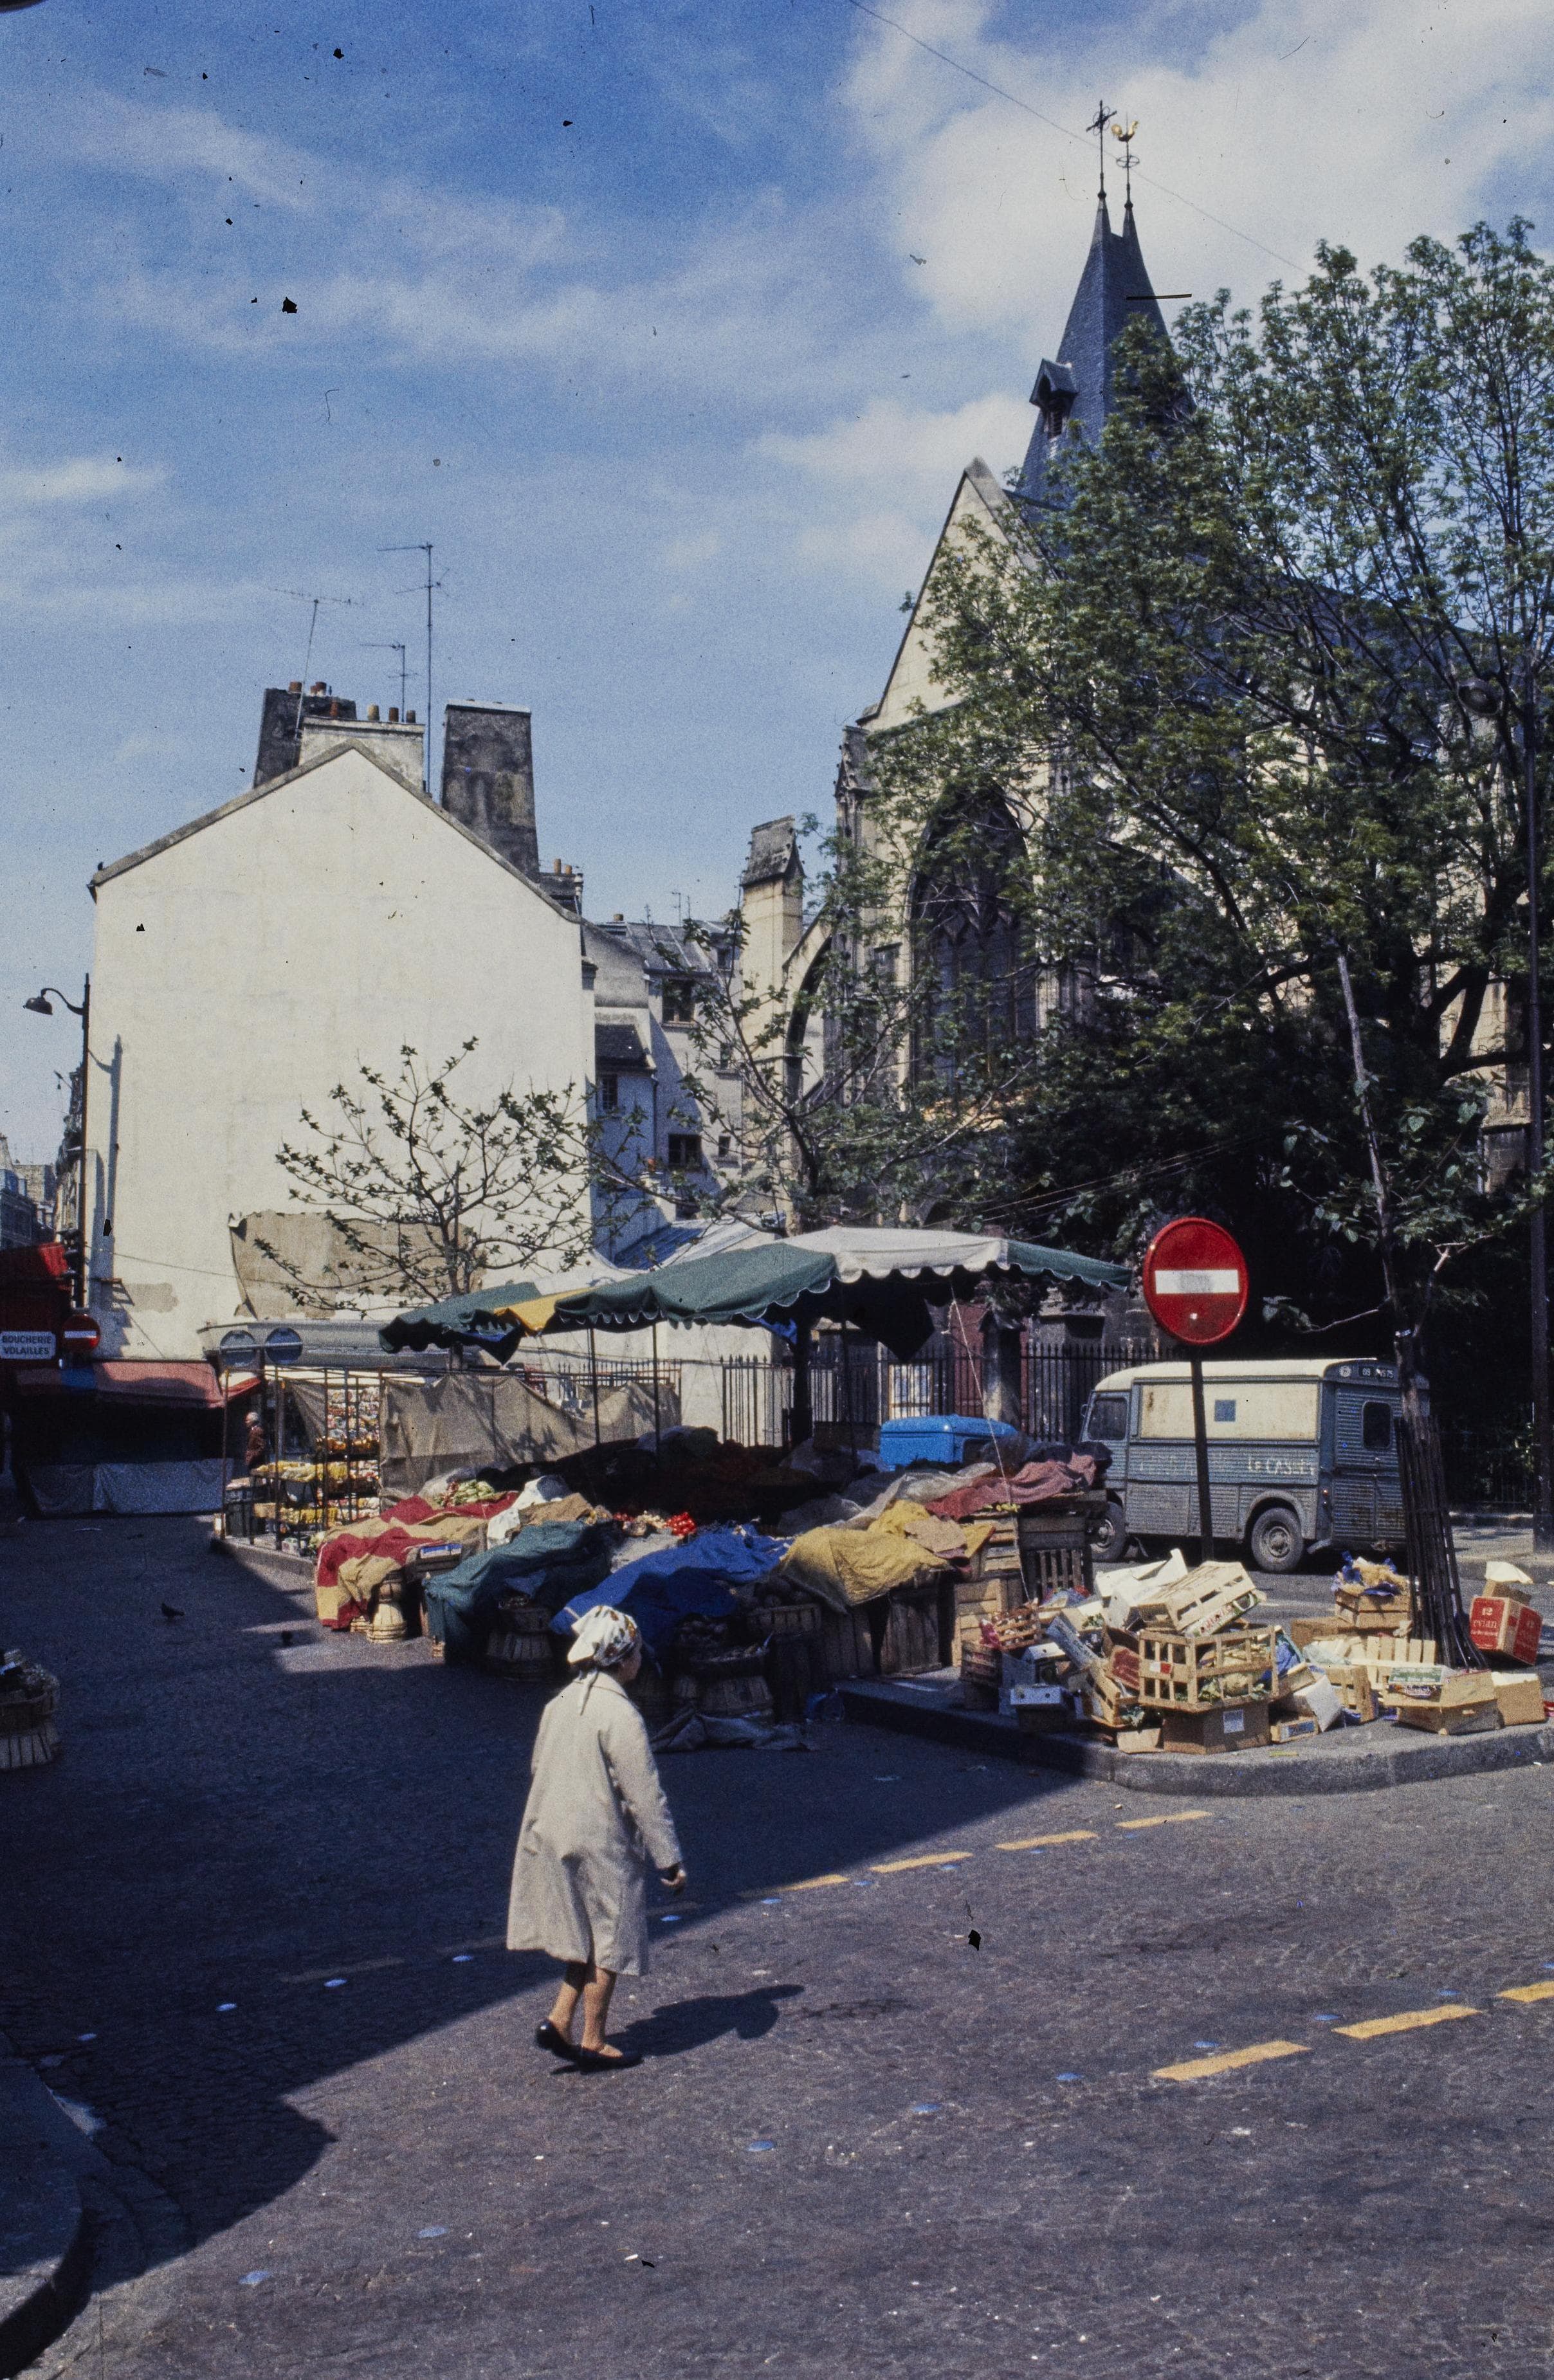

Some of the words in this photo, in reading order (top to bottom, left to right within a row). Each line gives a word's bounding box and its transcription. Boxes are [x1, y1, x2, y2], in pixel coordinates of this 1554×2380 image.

[3, 1335, 52, 1344] BOUCHERIE
[1482, 1607, 1493, 1616] 12
[1472, 1619, 1497, 1628] evian
